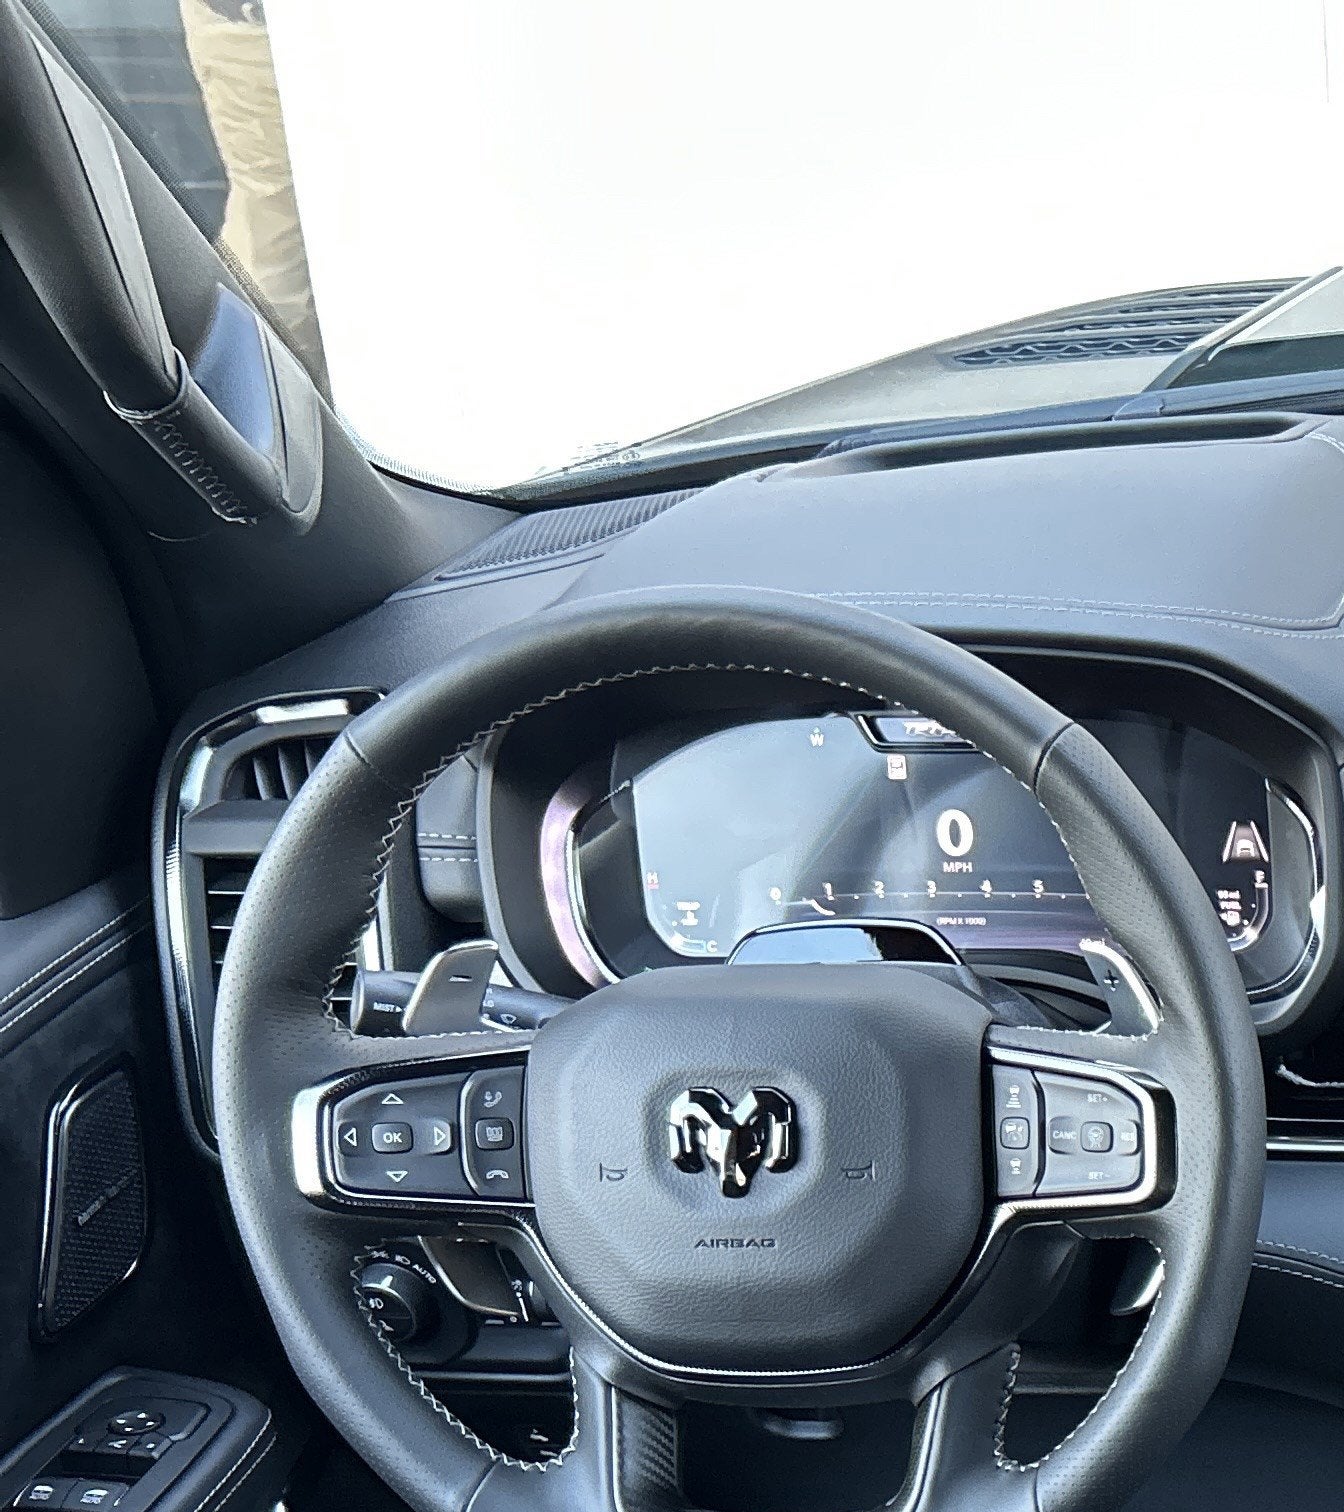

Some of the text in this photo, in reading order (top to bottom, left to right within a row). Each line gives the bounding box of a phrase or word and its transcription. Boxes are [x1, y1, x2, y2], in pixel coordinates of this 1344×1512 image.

[935, 808, 974, 857] 0
[942, 861, 973, 873] MPH
[383, 1132, 403, 1144] OK
[1052, 1130, 1077, 1140] CANC
[693, 1237, 777, 1249] AIRBAG
[412, 1262, 437, 1285] AUTO
